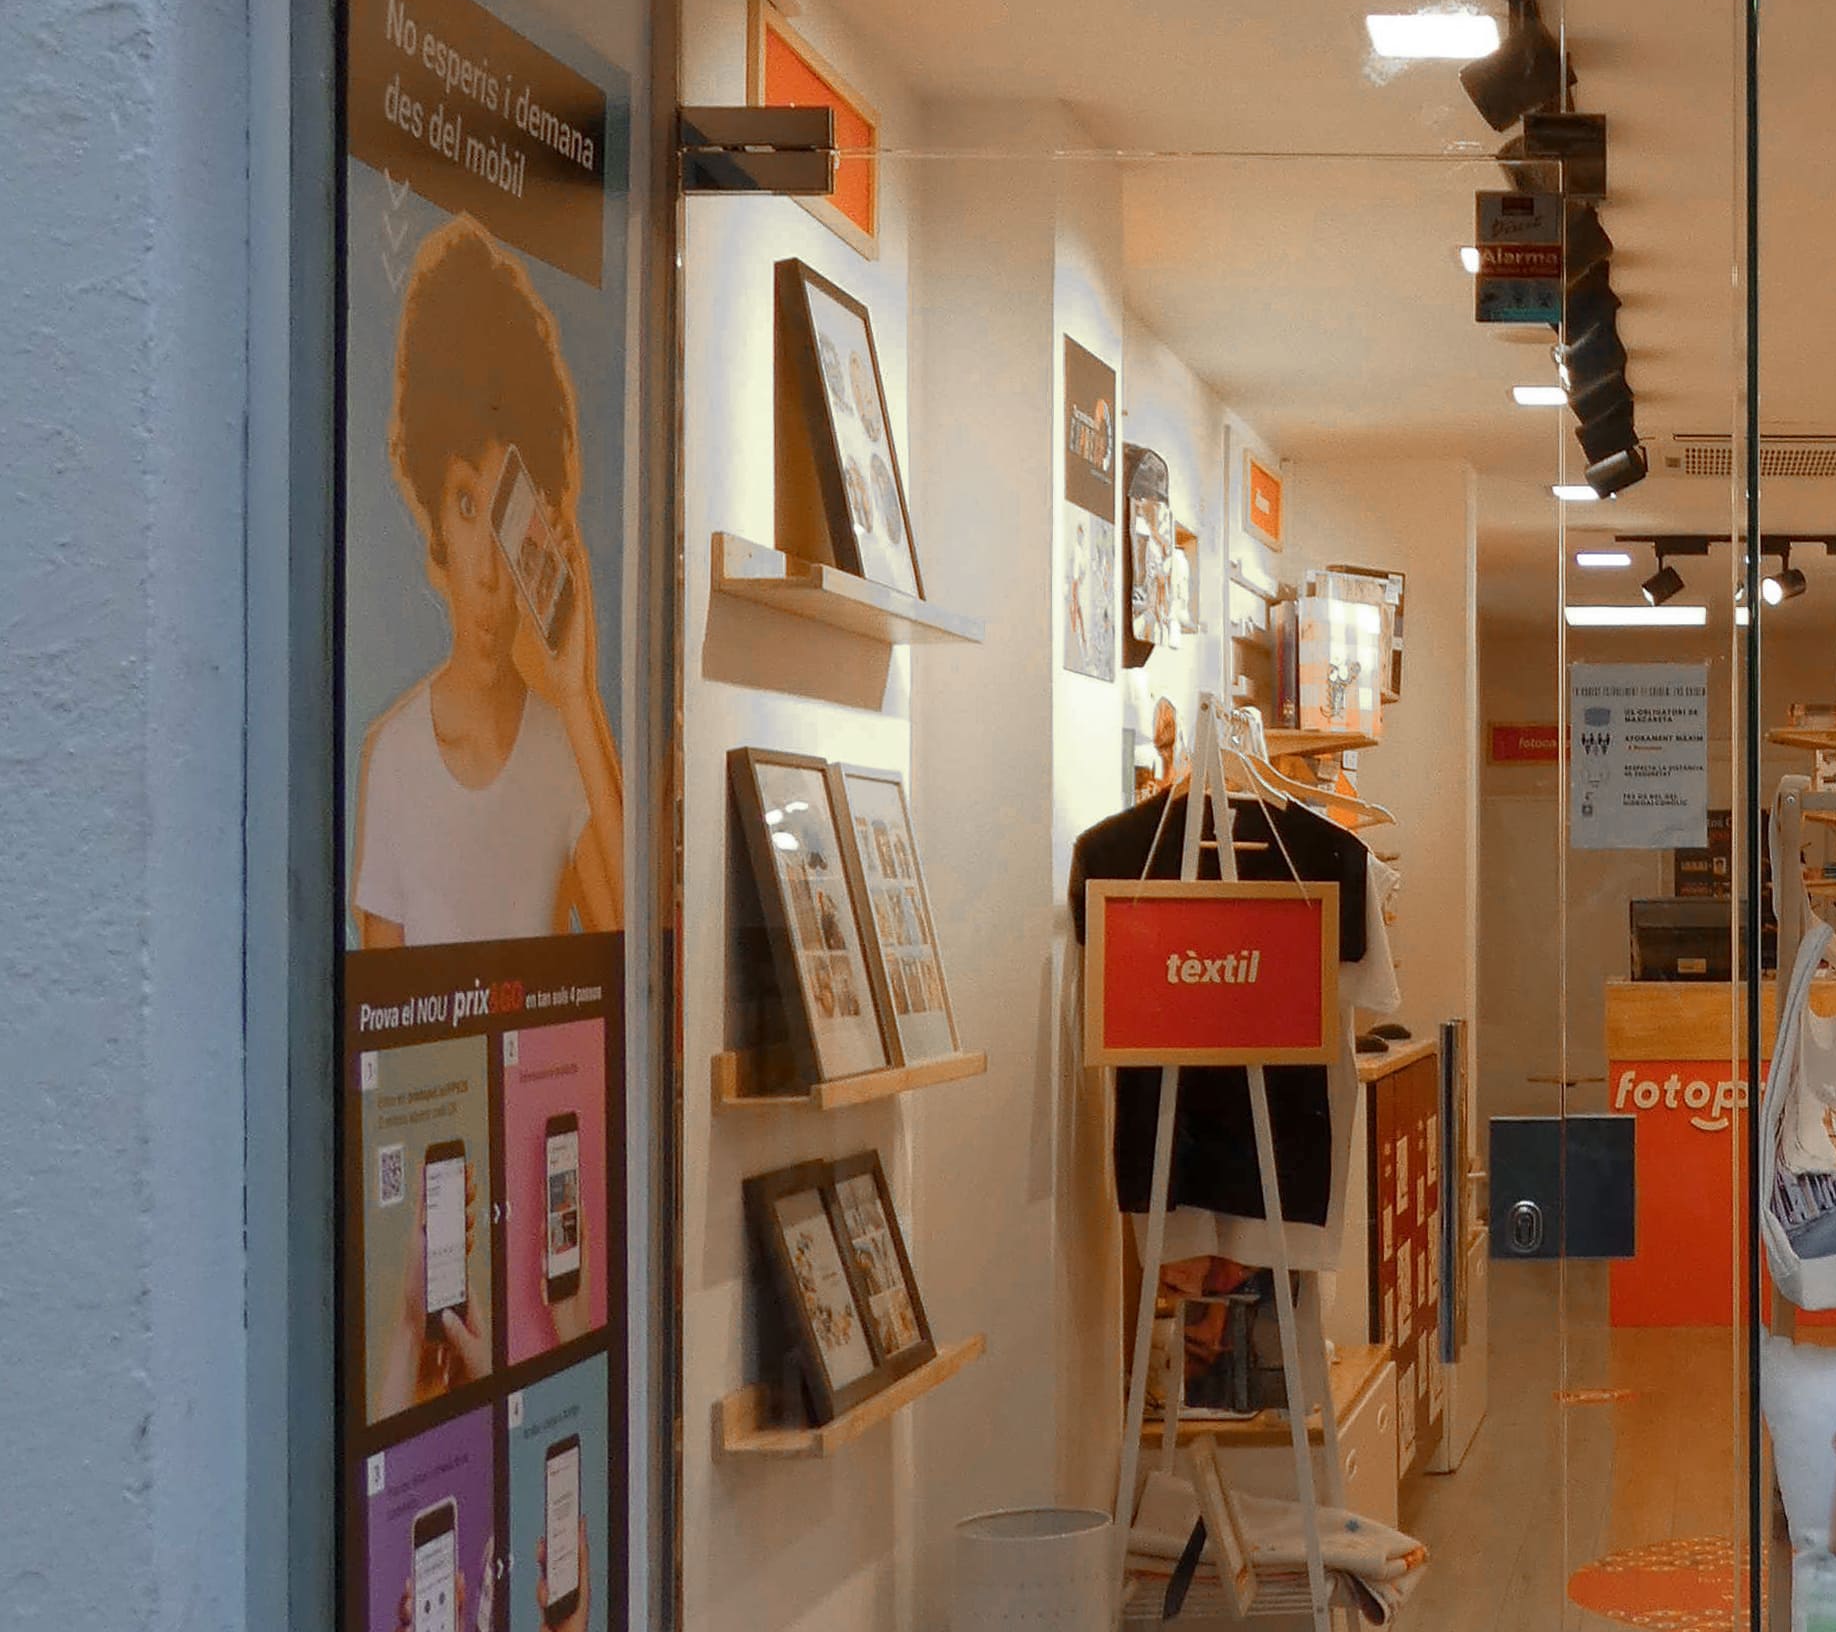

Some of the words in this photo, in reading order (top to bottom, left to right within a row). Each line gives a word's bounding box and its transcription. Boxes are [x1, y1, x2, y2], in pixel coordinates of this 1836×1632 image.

[385, 73, 424, 138] des
[429, 104, 462, 161] del
[466, 136, 525, 198] mòbil
[423, 34, 499, 110] esperis
[505, 74, 512, 119] i
[516, 86, 594, 171] demana
[1166, 949, 1260, 984] tèxtil
[360, 1003, 399, 1032] Prova
[402, 998, 414, 1026] el
[418, 995, 449, 1024] NOU
